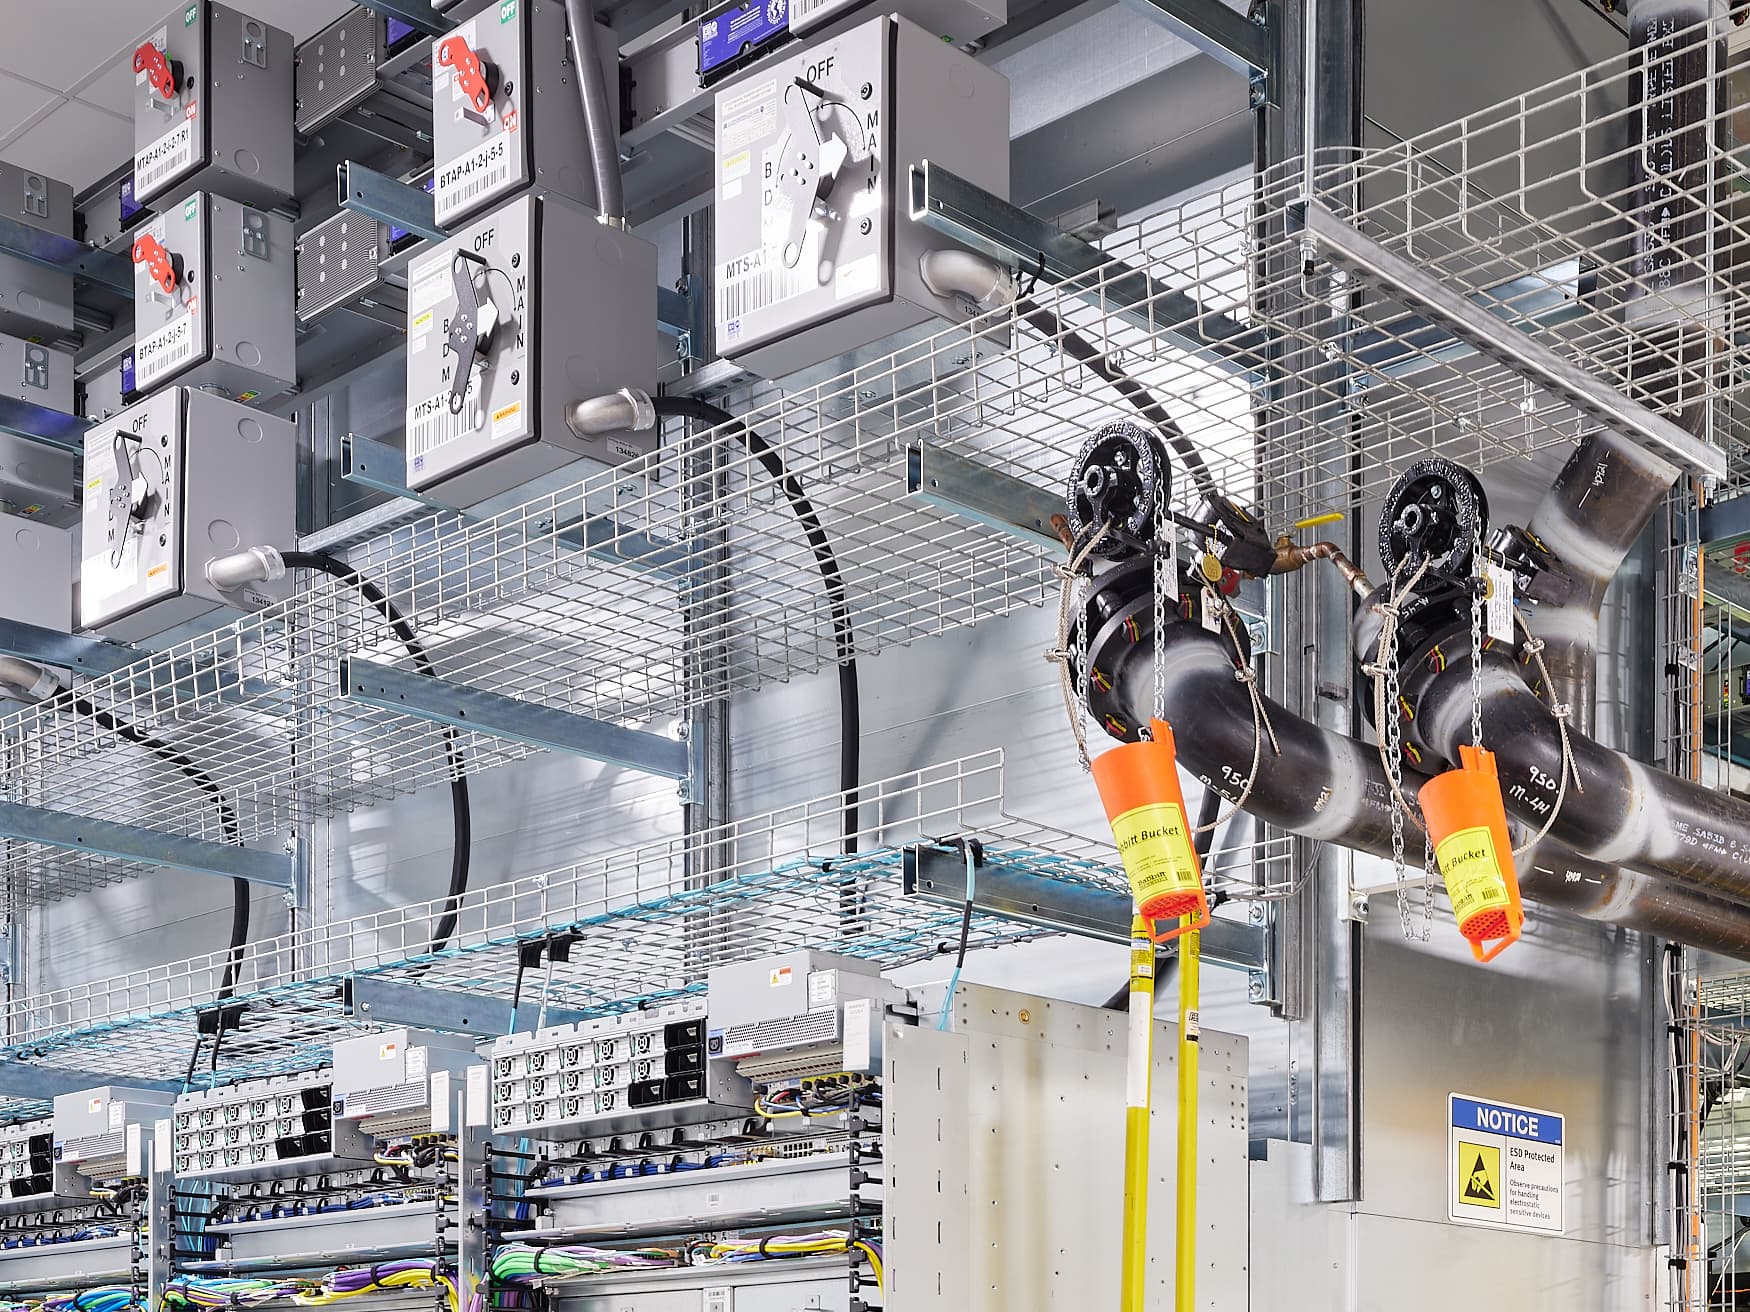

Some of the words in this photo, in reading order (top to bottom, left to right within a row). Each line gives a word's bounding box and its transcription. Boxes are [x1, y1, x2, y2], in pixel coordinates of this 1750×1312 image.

[186, 8, 197, 23] OFF
[501, 2, 515, 19] OFF
[807, 56, 835, 83] OFF
[186, 103, 196, 118] ON
[504, 113, 517, 130] ON
[186, 202, 196, 217] OFF
[474, 229, 494, 251] OFF
[187, 299, 196, 313] ON
[516, 277, 526, 349] MAIN
[132, 414, 148, 433] OFF
[1141, 826, 1180, 841] Bucket
[1451, 847, 1486, 869] Bucket
[1477, 1106, 1539, 1137] NOTICE
[1510, 1147, 1523, 1158] ESD
[1524, 1149, 1555, 1163] Protected
[1510, 1161, 1525, 1172] Area
[1510, 1179, 1530, 1189] Observe
[1531, 1183, 1558, 1194] precautions
[1518, 1190, 1539, 1200] handling
[1510, 1199, 1540, 1209] electrostatic
[1533, 1211, 1551, 1220] devices
